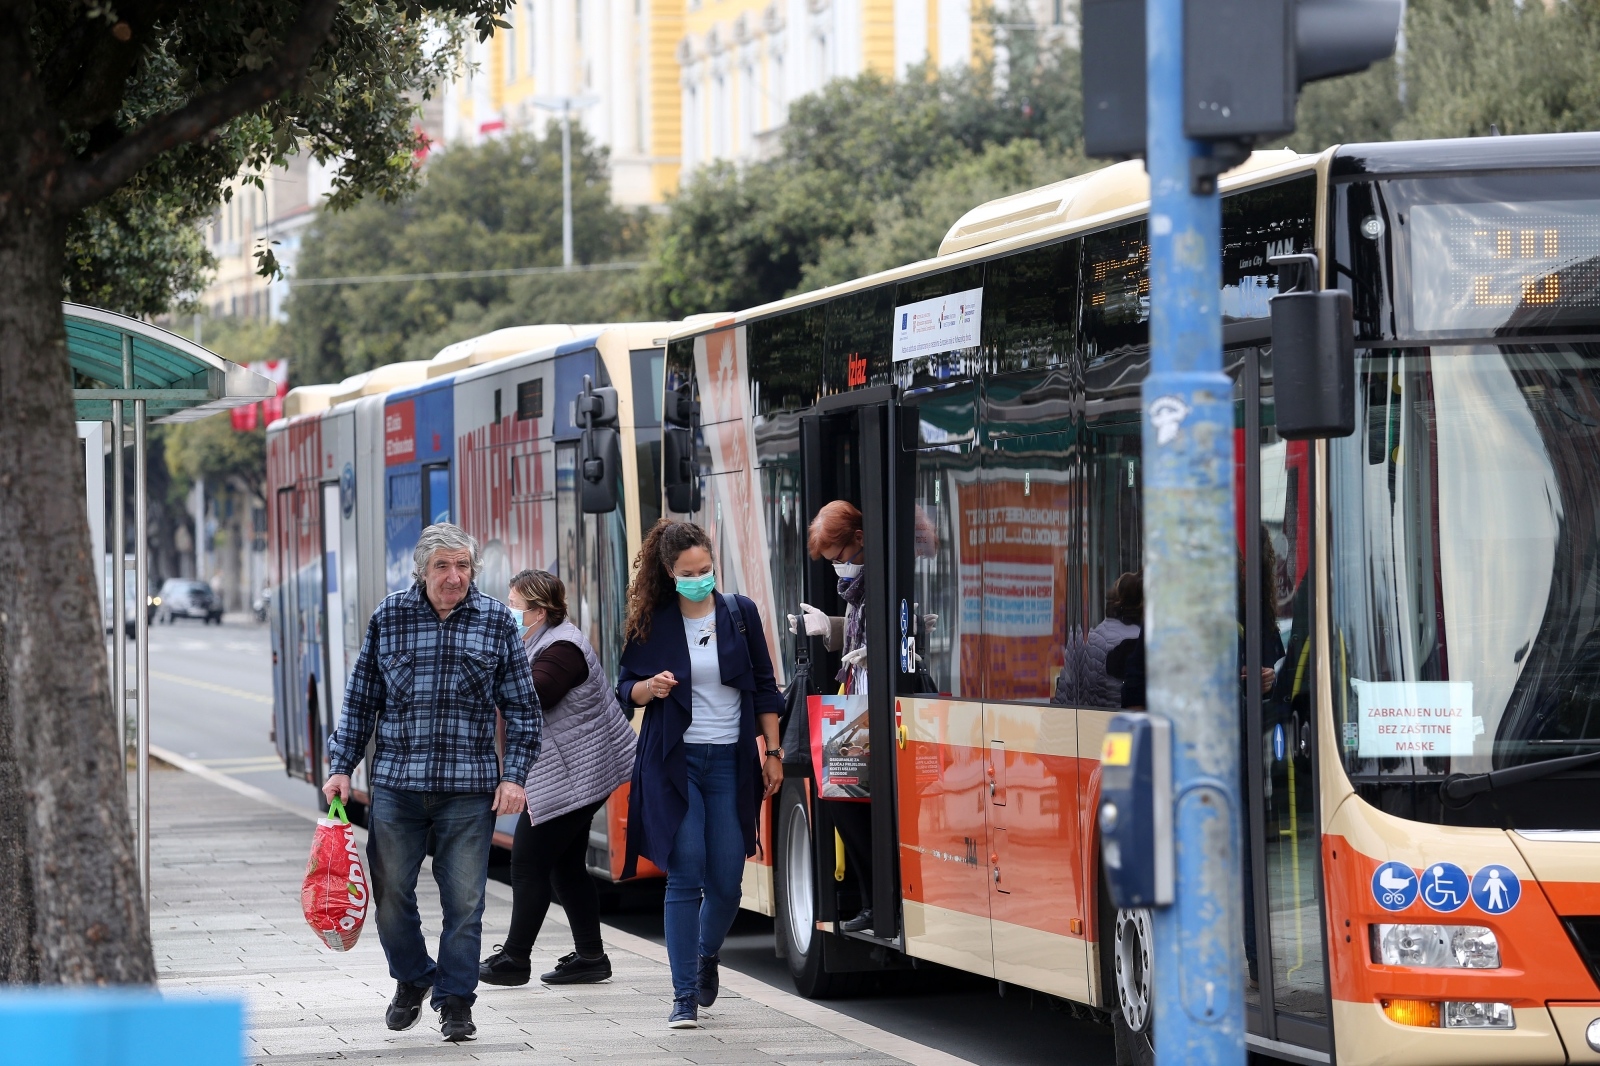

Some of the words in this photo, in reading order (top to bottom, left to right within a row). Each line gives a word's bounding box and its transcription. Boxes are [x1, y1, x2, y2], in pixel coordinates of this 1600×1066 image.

[1266, 237, 1294, 263] MAN
[848, 352, 867, 387] Izlaz
[1367, 708, 1431, 717] ZABRANJEN
[1434, 708, 1463, 717] ULAZ
[1378, 725, 1397, 734] BEZ
[1400, 723, 1452, 734] ZAŠTITNE
[1395, 742, 1435, 751] MASKE
[339, 827, 367, 930] PLODIN
